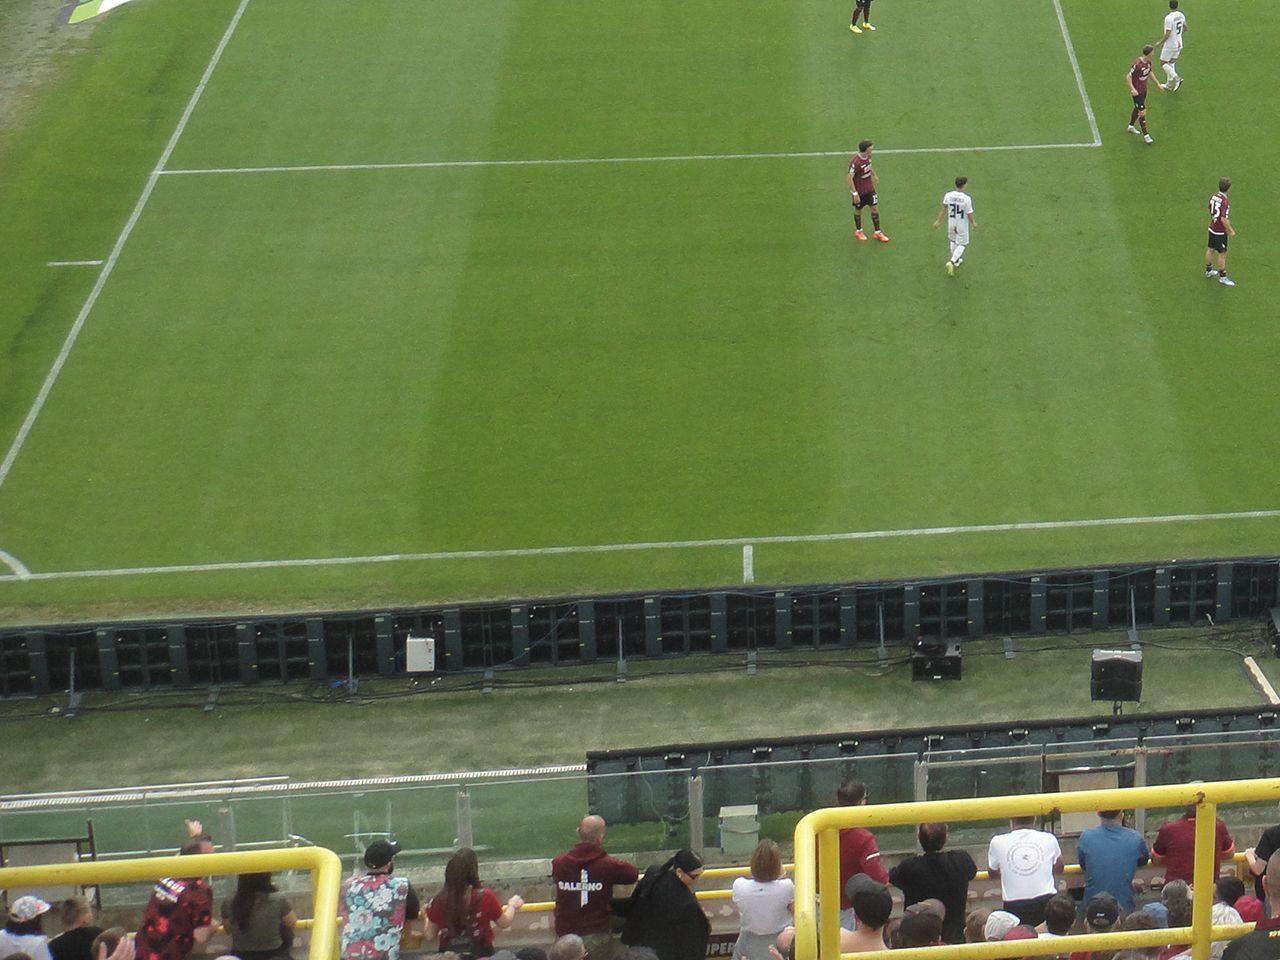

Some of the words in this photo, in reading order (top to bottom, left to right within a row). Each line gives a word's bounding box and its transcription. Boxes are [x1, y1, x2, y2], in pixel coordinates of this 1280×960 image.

[1175, 21, 1182, 35] 5
[948, 203, 965, 220] 34
[558, 880, 604, 892] SALERNO
